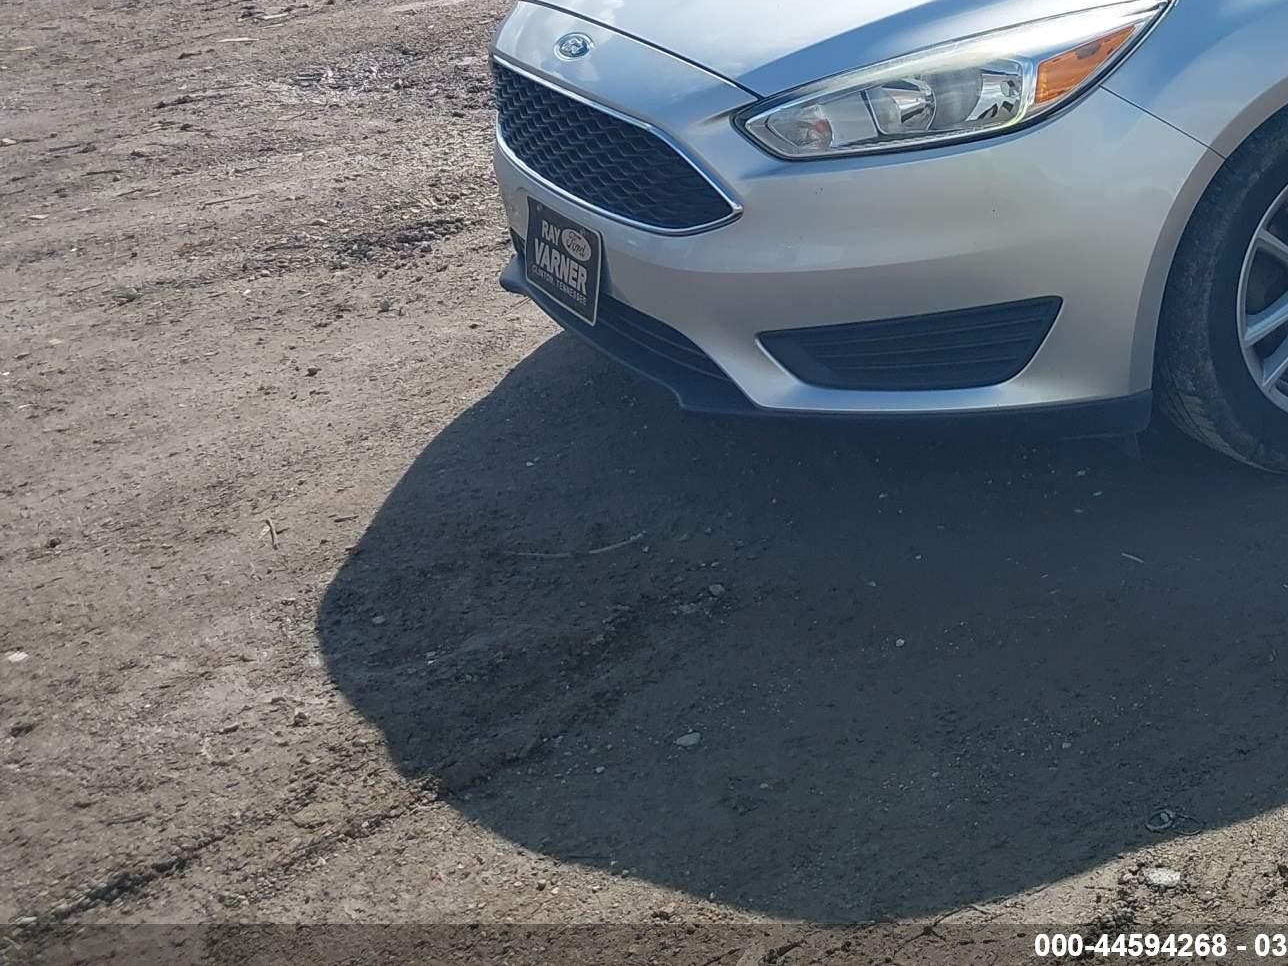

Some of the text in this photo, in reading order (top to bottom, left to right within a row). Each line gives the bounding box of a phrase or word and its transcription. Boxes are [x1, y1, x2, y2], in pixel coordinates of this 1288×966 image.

[541, 219, 560, 246] RAY
[565, 230, 588, 258] Ford
[534, 237, 588, 297] VARNER
